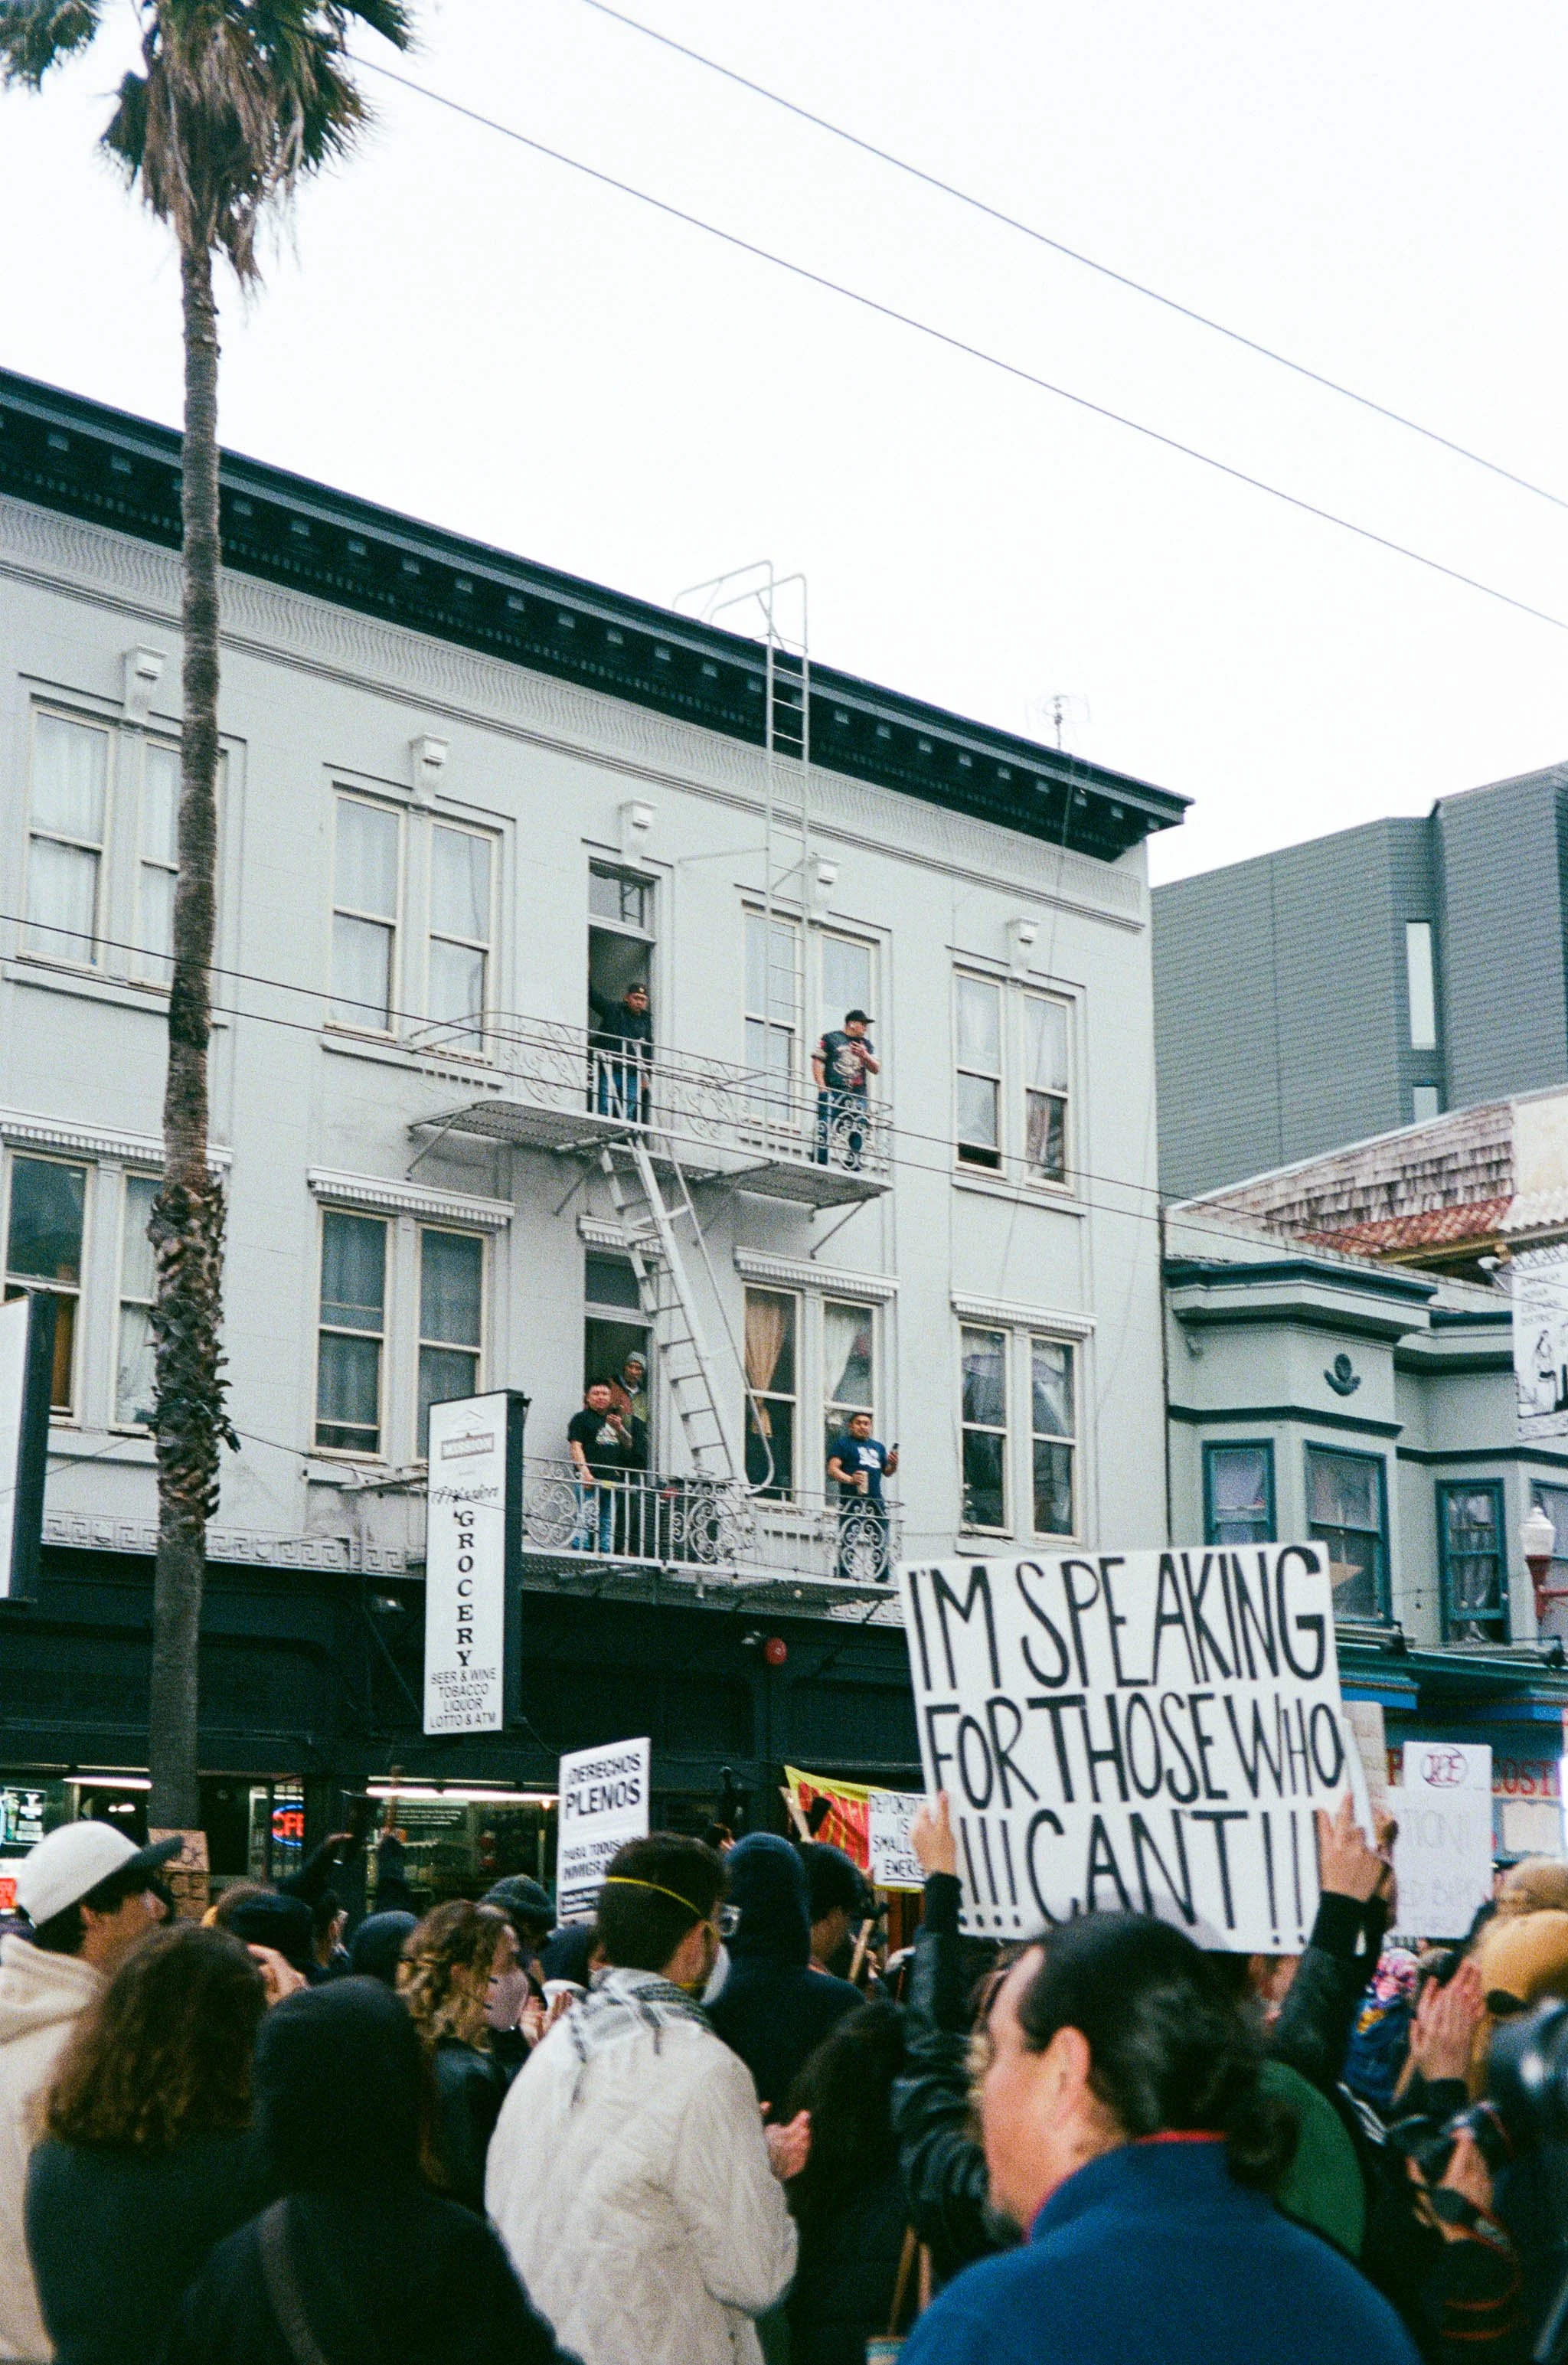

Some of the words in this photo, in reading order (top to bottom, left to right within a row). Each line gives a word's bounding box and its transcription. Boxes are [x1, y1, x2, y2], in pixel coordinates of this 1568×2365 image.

[456, 1511, 474, 1667] GROCERY
[908, 1565, 1001, 1690] I'M
[1016, 1545, 1326, 1687] SPEAKING
[431, 1671, 457, 1684] BEER
[471, 1668, 496, 1680] WINE
[439, 1683, 488, 1697] TOBACCO
[444, 1697, 483, 1712] LIQUOR
[430, 1714, 462, 1728] LOTTO
[475, 1711, 496, 1726] ATM
[924, 1696, 1040, 1809] FOR
[1027, 1691, 1230, 1804] THOSE
[1223, 1692, 1346, 1796] WHO
[565, 1778, 642, 1820] PLENOS
[884, 1858, 925, 1877] EMERG
